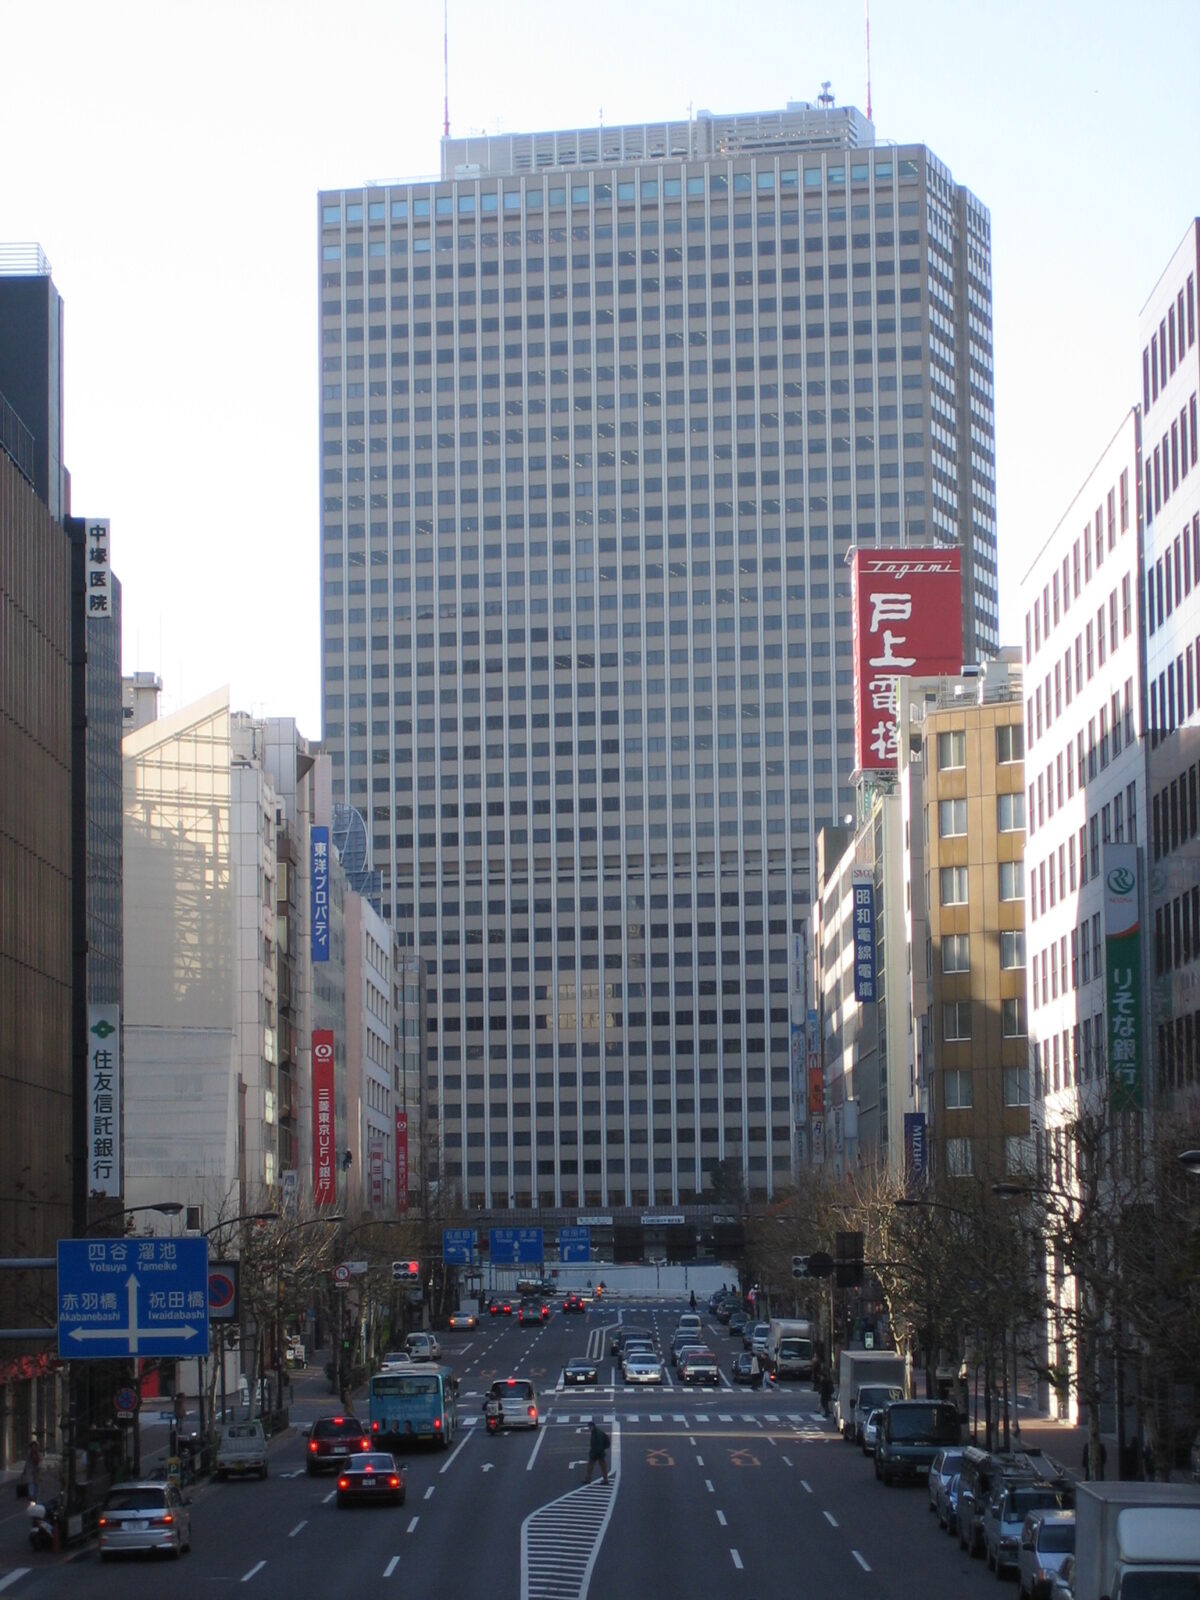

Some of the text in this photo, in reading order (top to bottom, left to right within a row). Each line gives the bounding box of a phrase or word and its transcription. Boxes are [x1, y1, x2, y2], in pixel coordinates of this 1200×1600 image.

[89, 524, 108, 611] 中塚医院
[314, 842, 327, 946] 東洋プロパティ
[1112, 967, 1137, 1085] りそな銀行
[93, 1049, 113, 1180] 住友信託銀行
[318, 1088, 331, 1190] 三菱東京UFJ銀行
[912, 1125, 922, 1171] MIZUHO
[88, 1242, 176, 1261] 四谷 溜池
[89, 1261, 177, 1273] Yotsuya Tameike
[60, 1311, 120, 1321] Akabanebashi
[62, 1292, 117, 1310] 赤羽橋
[148, 1310, 205, 1320] Iwaidabashi
[149, 1291, 204, 1309] 祝田橋
